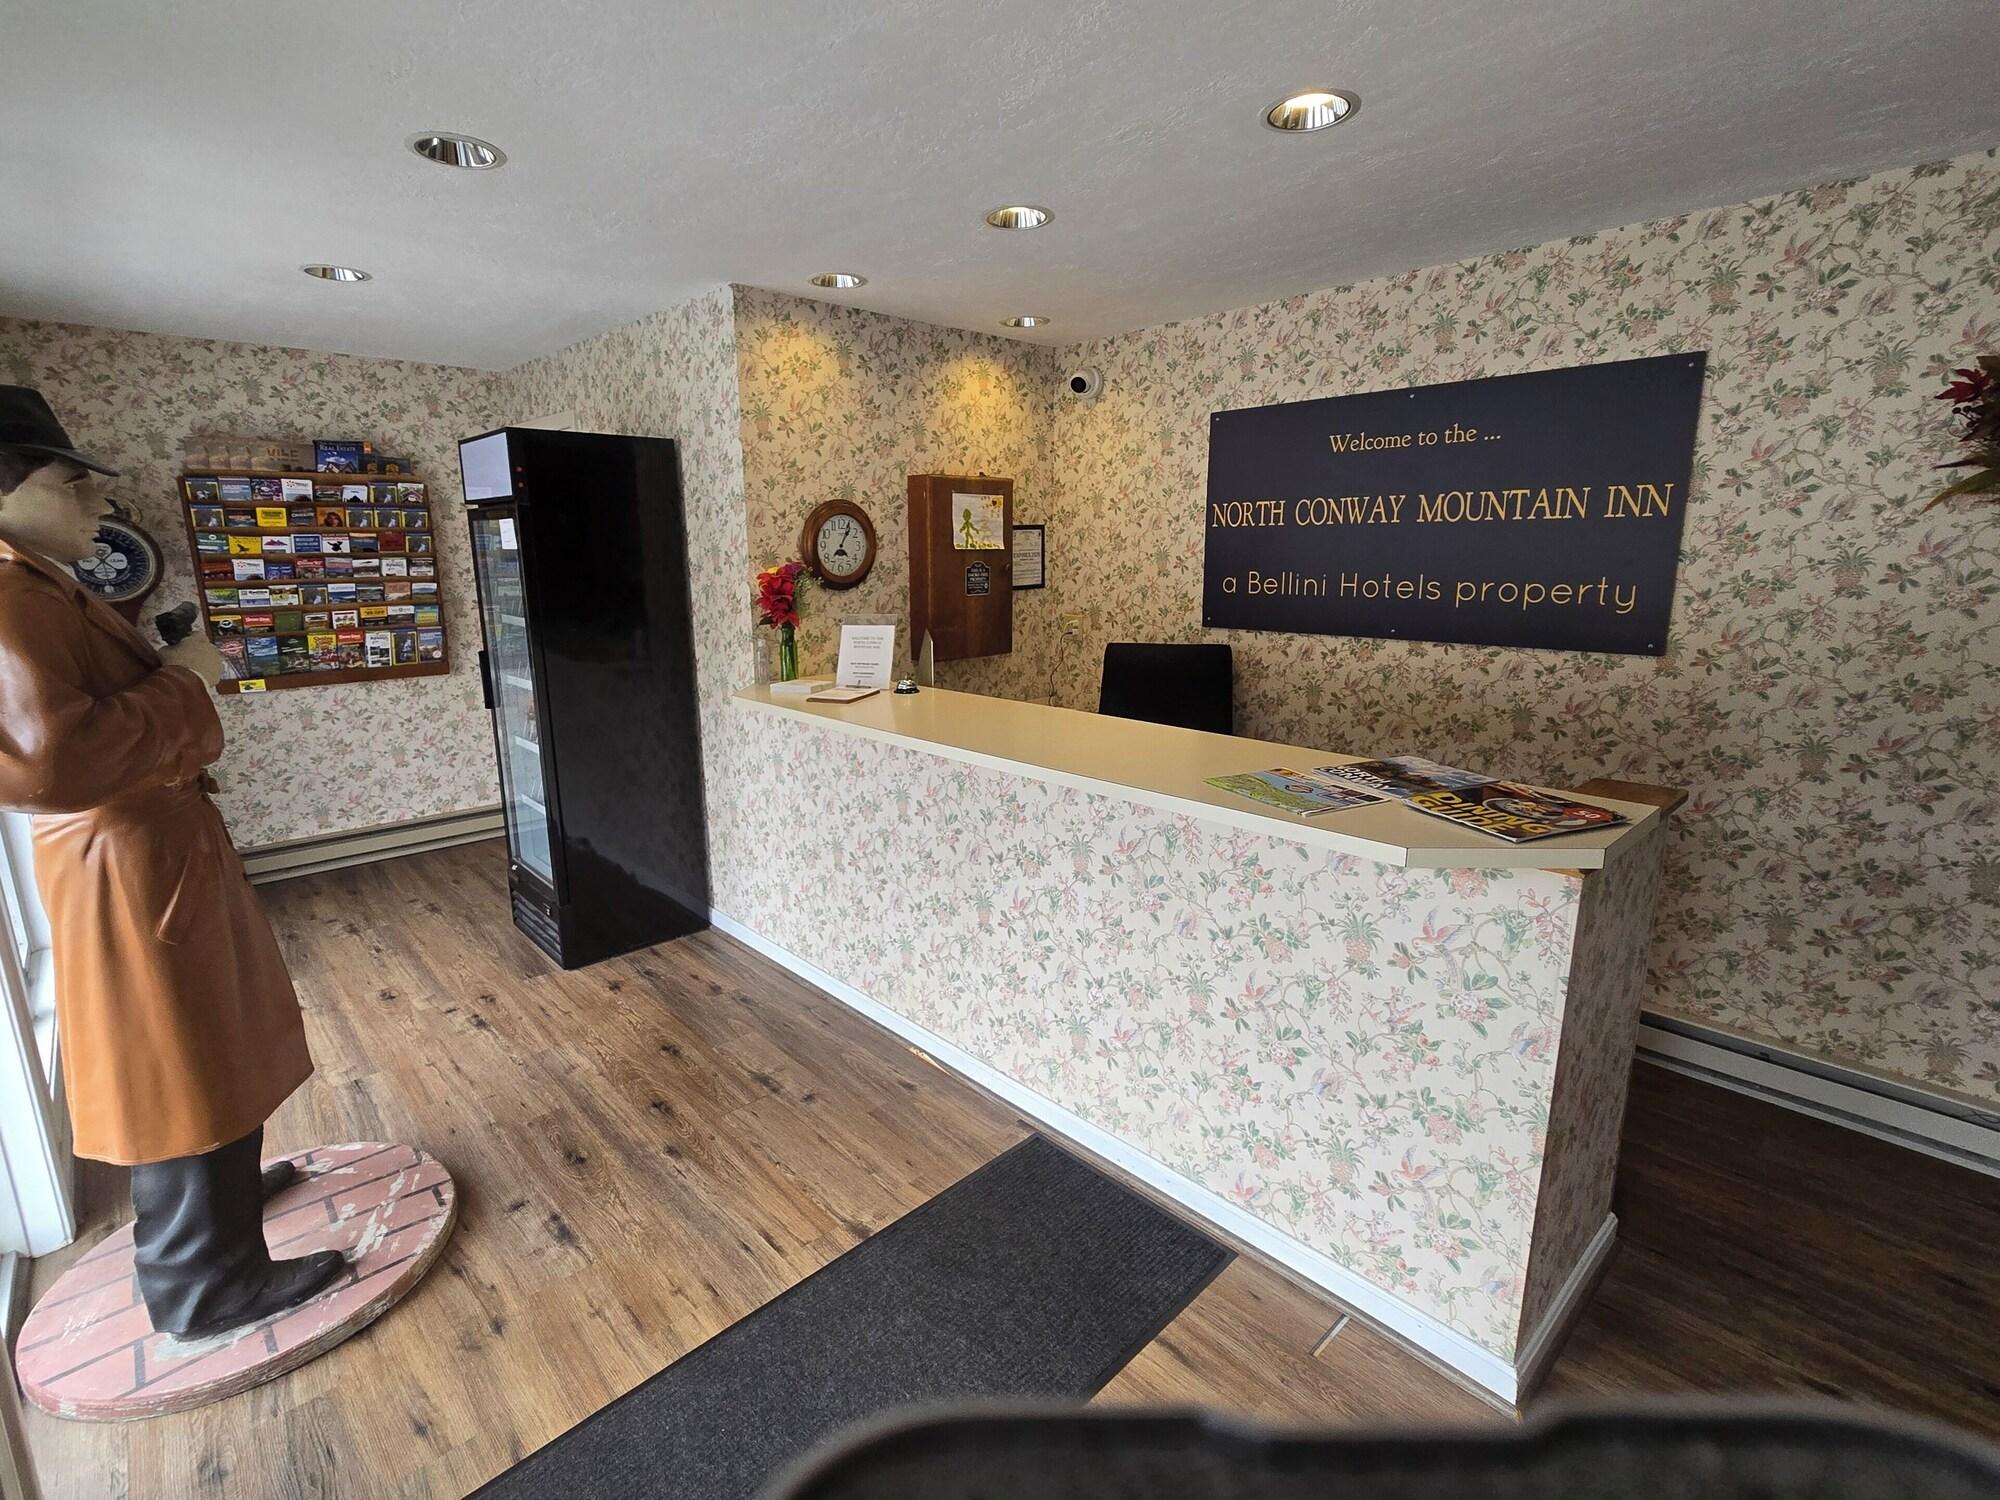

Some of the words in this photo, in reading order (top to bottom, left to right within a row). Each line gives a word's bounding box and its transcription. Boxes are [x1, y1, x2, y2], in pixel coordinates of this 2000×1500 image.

[1329, 431, 1412, 454] Welcome
[1418, 431, 1438, 446] to
[1444, 424, 1478, 445] the
[1212, 499, 1285, 528] NORTH
[1294, 494, 1406, 526] CONWAY
[1416, 487, 1591, 523] MOUNTAIN
[1603, 483, 1675, 518] INN
[1222, 576, 1237, 594] a
[1247, 571, 1327, 597] Bellini
[1341, 573, 1440, 600] Hotels
[1456, 577, 1637, 614] property
[1409, 795, 1515, 833] GUIDE
[1430, 791, 1554, 834] DINING
